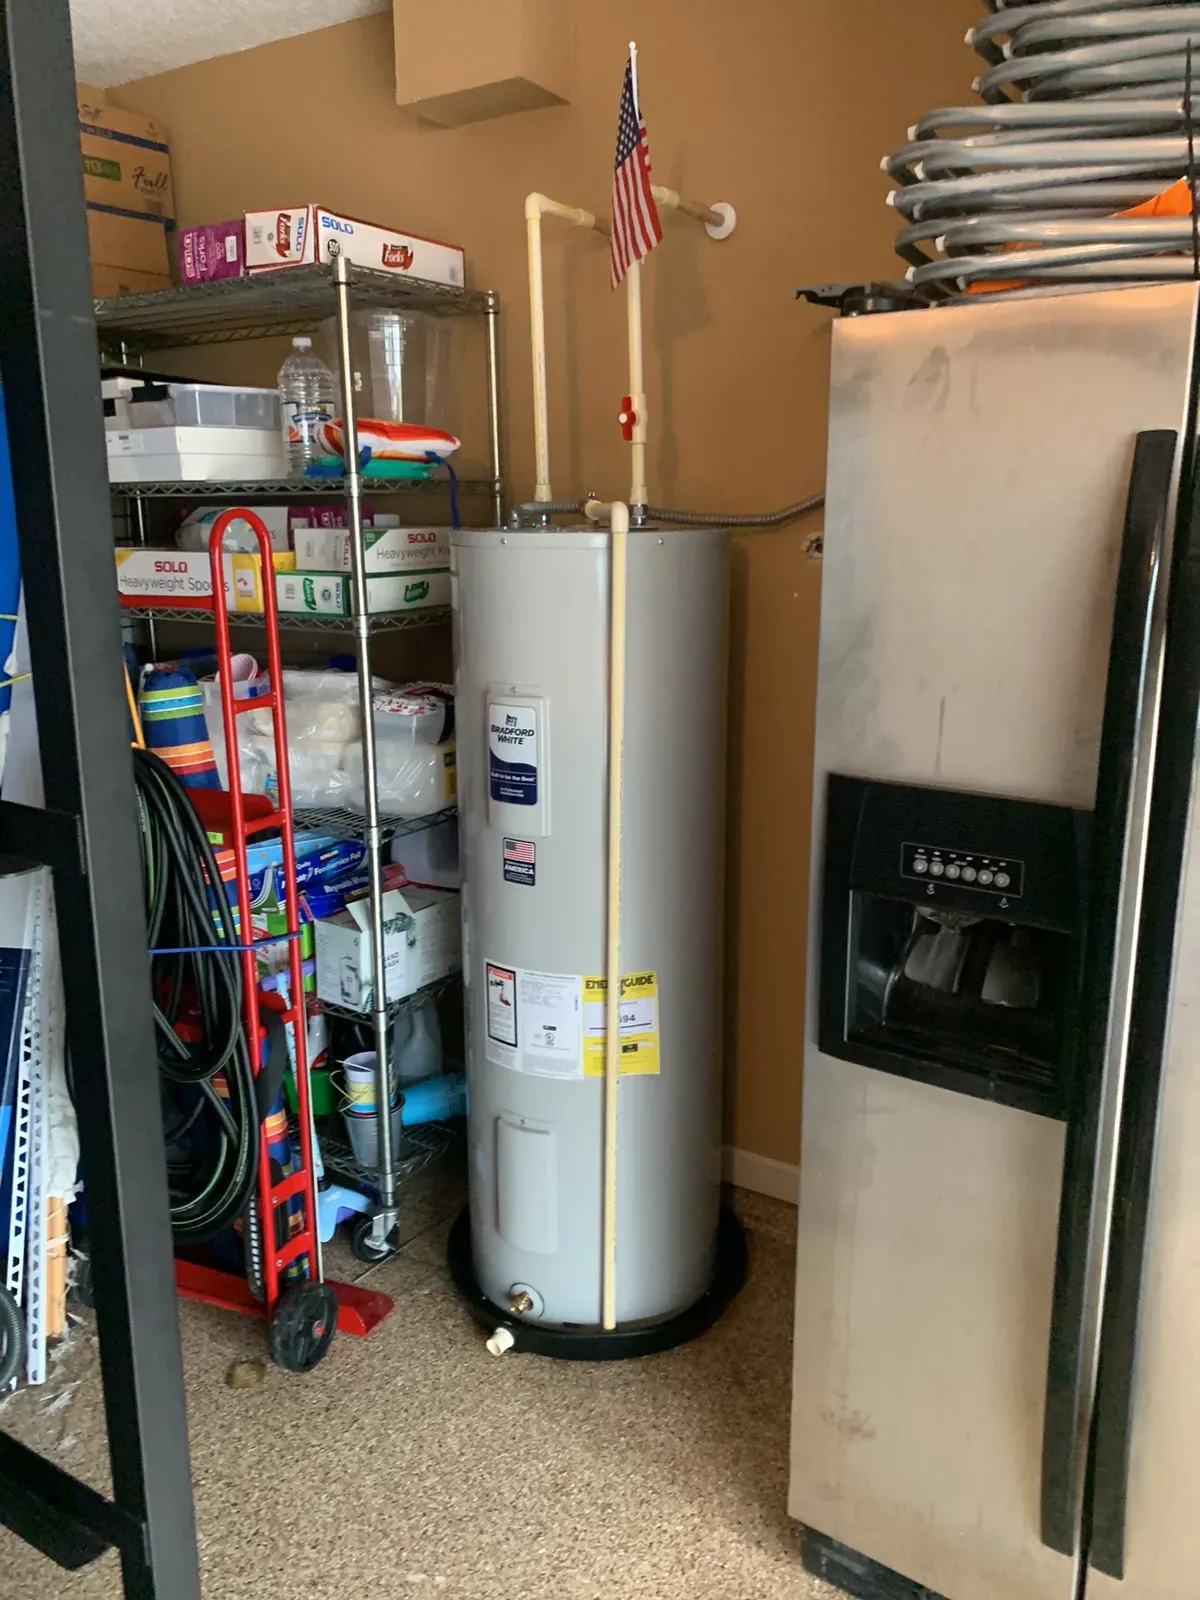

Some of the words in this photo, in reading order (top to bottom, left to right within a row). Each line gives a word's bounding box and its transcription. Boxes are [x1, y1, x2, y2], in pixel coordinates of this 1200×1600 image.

[279, 217, 291, 245] Forks
[322, 216, 354, 234] SOLO
[296, 217, 304, 252] SOLO
[184, 232, 195, 277] SOLO
[198, 236, 207, 271] Forks
[329, 241, 340, 254] 500
[384, 249, 404, 263] Forks
[408, 532, 436, 543] SOLO
[376, 545, 435, 560] Heavyweight
[154, 561, 187, 573] SOLO
[120, 575, 184, 591] Heavyweight
[188, 577, 230, 592] Spos
[490, 724, 535, 737] BRADFORD
[497, 735, 524, 745] WHITE
